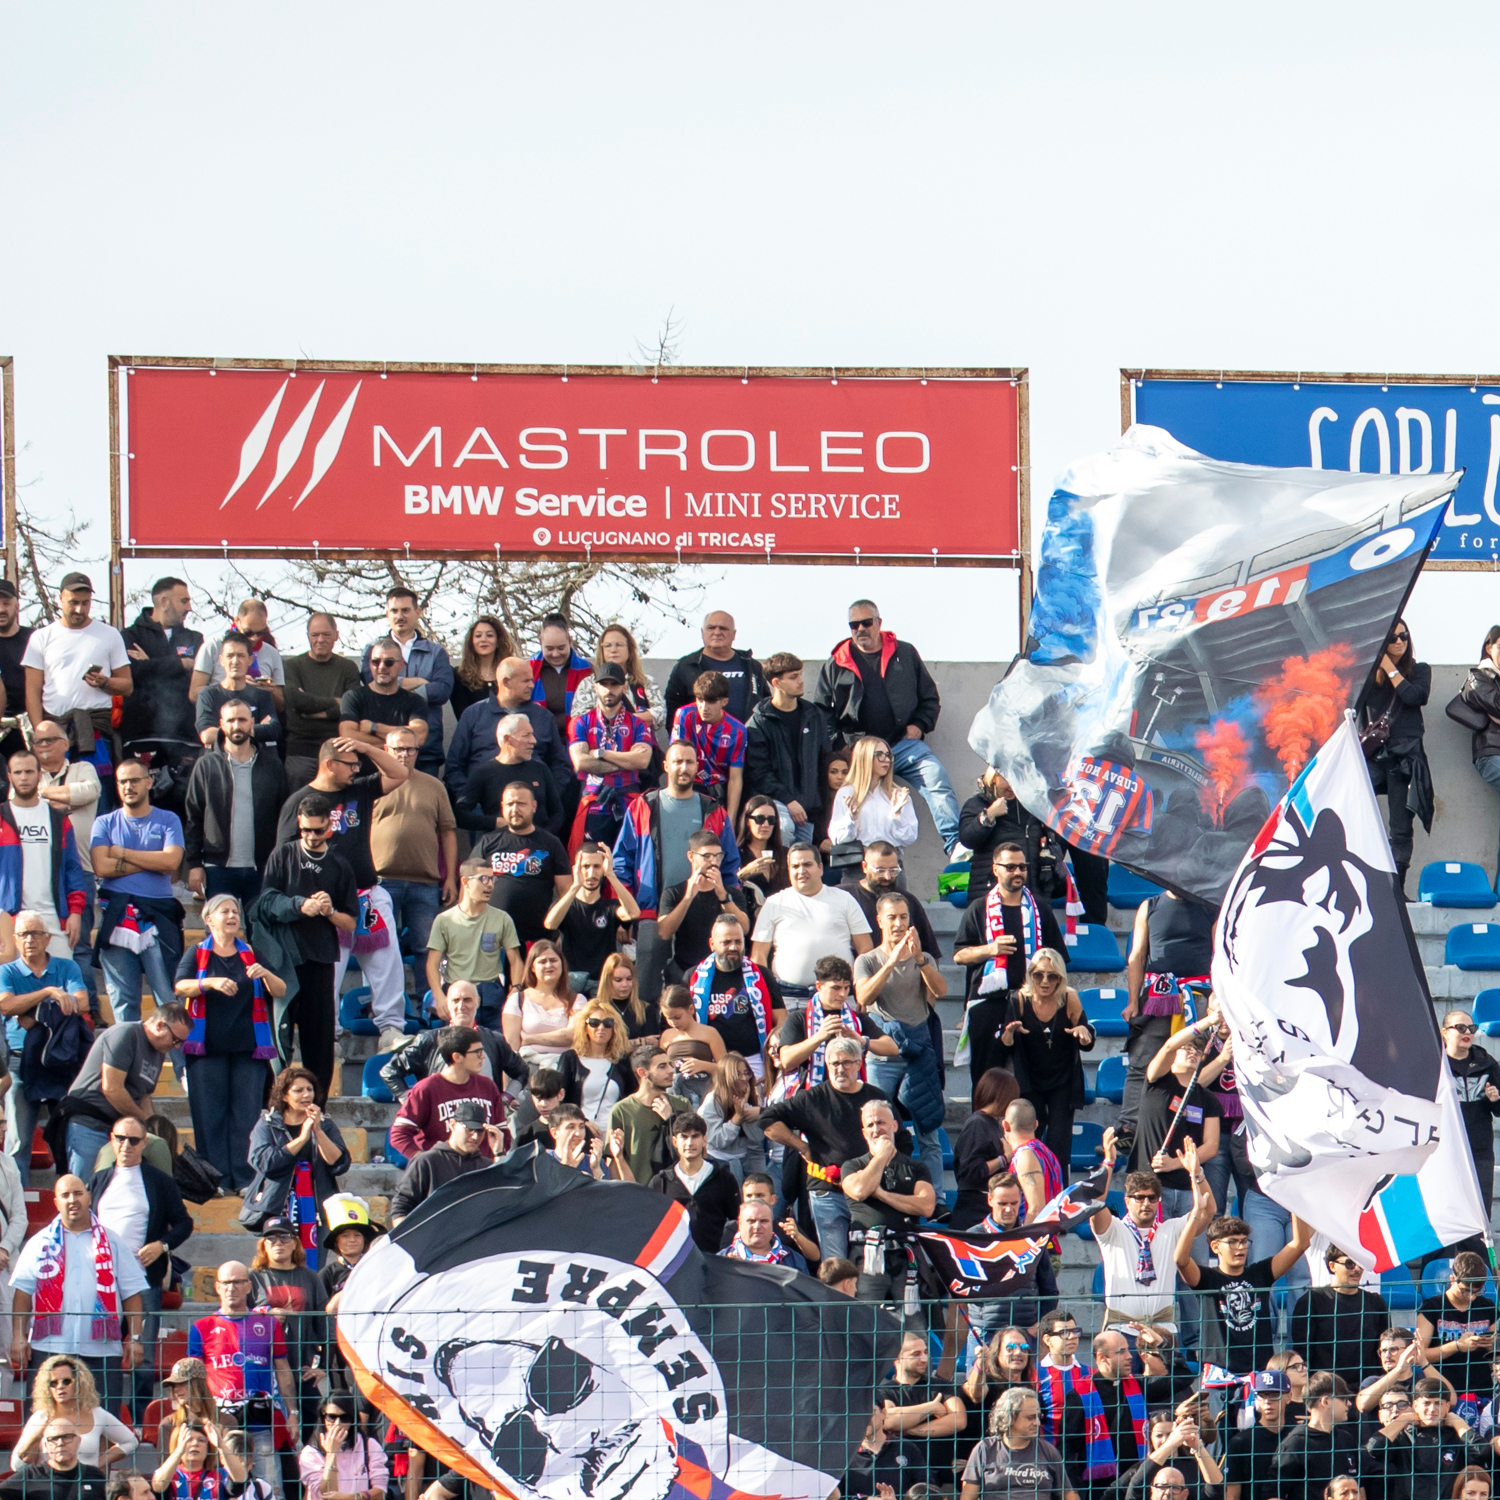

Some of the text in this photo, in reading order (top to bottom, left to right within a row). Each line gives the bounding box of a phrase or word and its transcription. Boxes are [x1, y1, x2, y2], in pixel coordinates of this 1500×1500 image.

[372, 423, 932, 476] MASTROLEO
[404, 486, 901, 520] BMW Service MINI SERVICE
[558, 531, 776, 548] LUCUGNANO di TRICASE
[1459, 534, 1499, 550] for
[491, 852, 525, 862] CUSP
[301, 861, 323, 874] LOVE
[491, 861, 518, 874] 1980
[711, 993, 733, 1004] USP
[708, 1004, 728, 1015] 980
[512, 1258, 720, 1427] SEMPRE
[1005, 1466, 1049, 1480] Hard Rock
